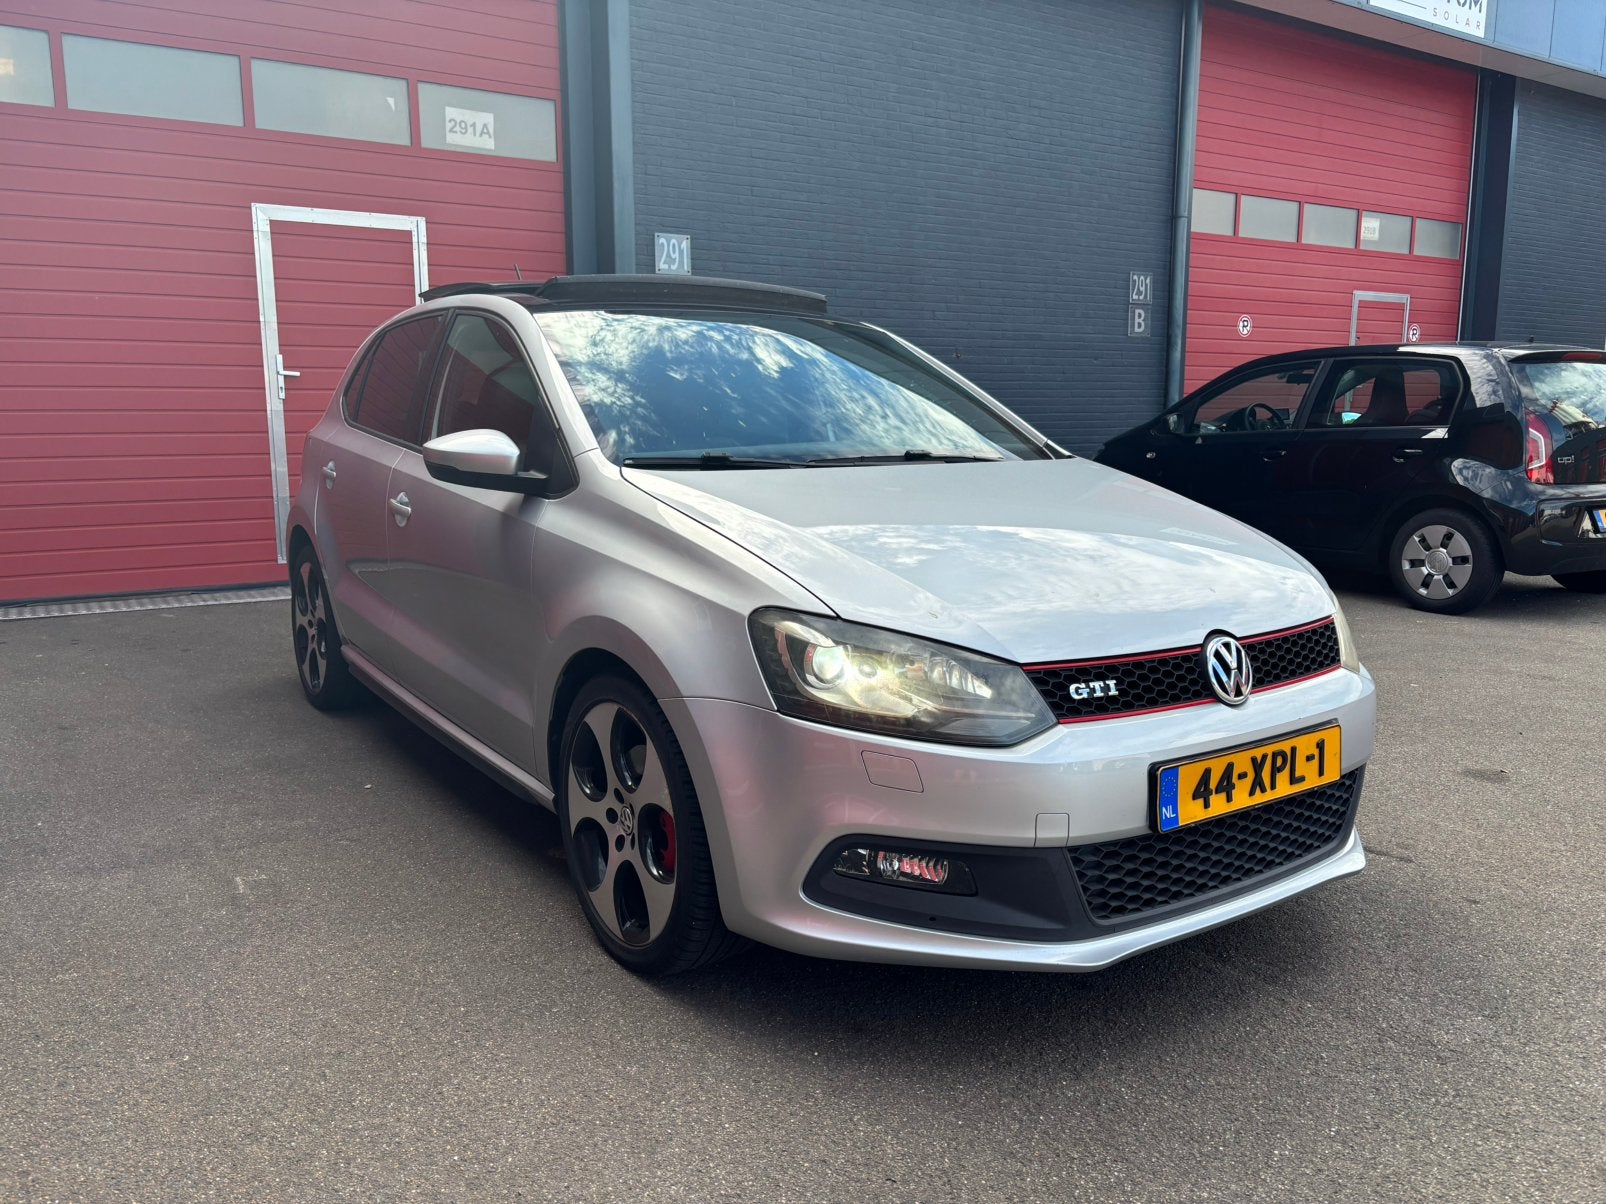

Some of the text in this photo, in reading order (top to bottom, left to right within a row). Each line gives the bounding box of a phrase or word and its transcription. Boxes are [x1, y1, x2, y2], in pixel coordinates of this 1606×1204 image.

[1433, 7, 1481, 30] SOLAR
[448, 118, 492, 139] 291A
[659, 237, 688, 271] 291
[1132, 275, 1150, 300] 291
[1134, 309, 1145, 333] B
[1557, 455, 1575, 465] up!
[1069, 679, 1119, 700] GTI
[1192, 738, 1326, 810] 44-XPL-1
[1162, 804, 1176, 820] NL
